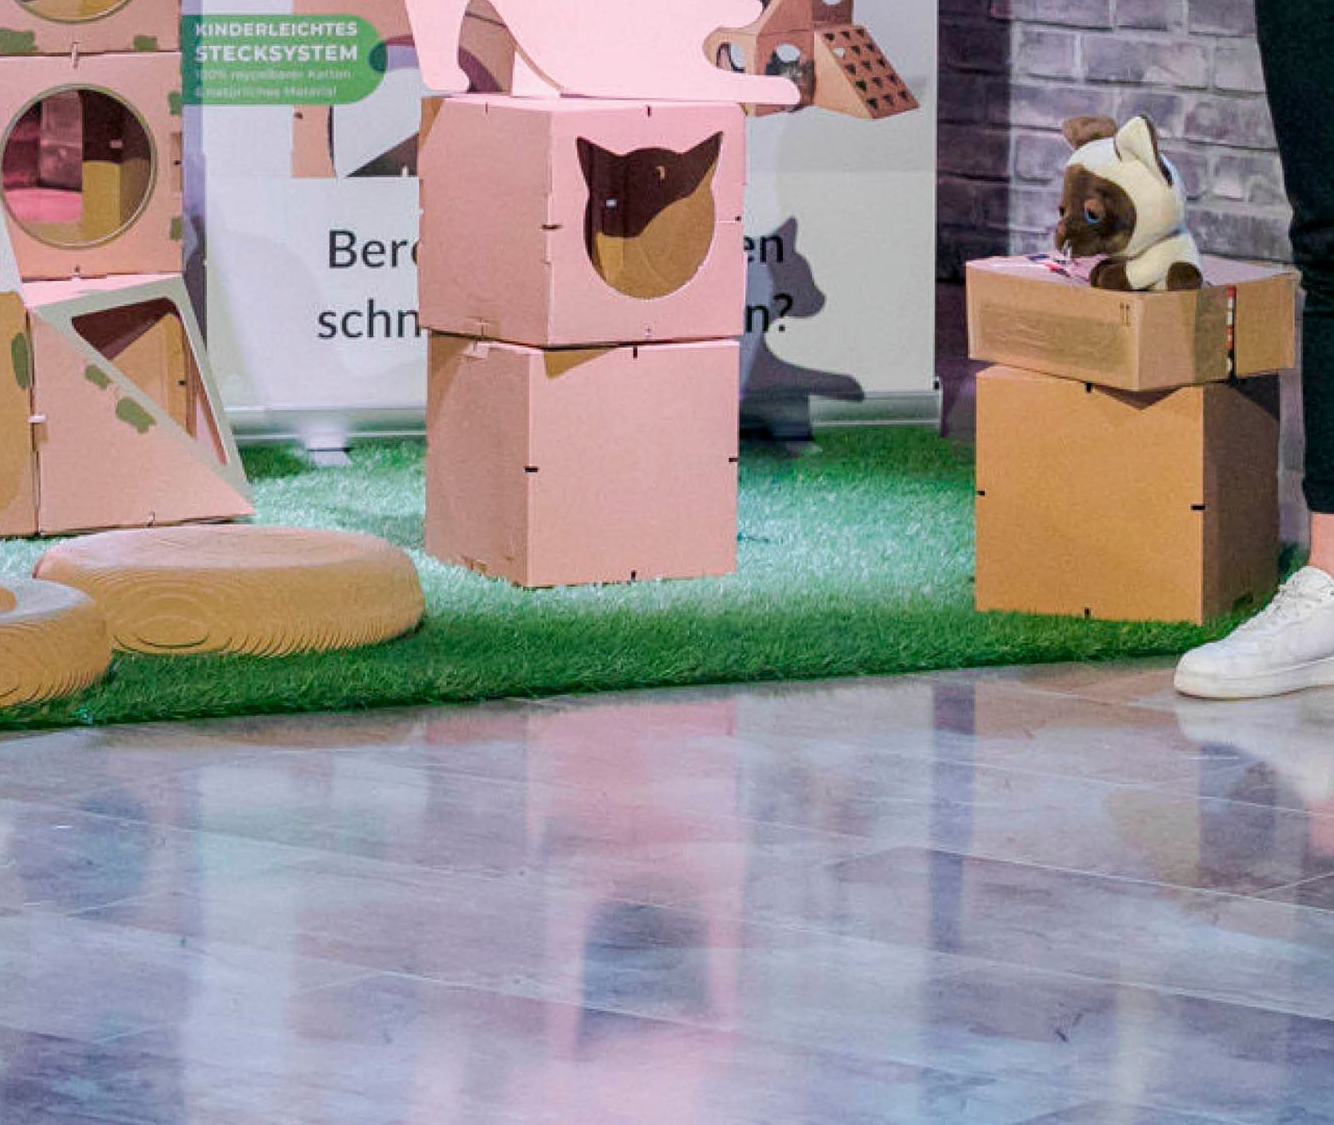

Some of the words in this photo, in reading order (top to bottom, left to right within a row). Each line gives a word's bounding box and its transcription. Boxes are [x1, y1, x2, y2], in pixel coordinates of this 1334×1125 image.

[195, 22, 358, 37] KINDERLEICHTES
[195, 45, 358, 62] STECKSYSTEM
[328, 229, 419, 269] Ber
